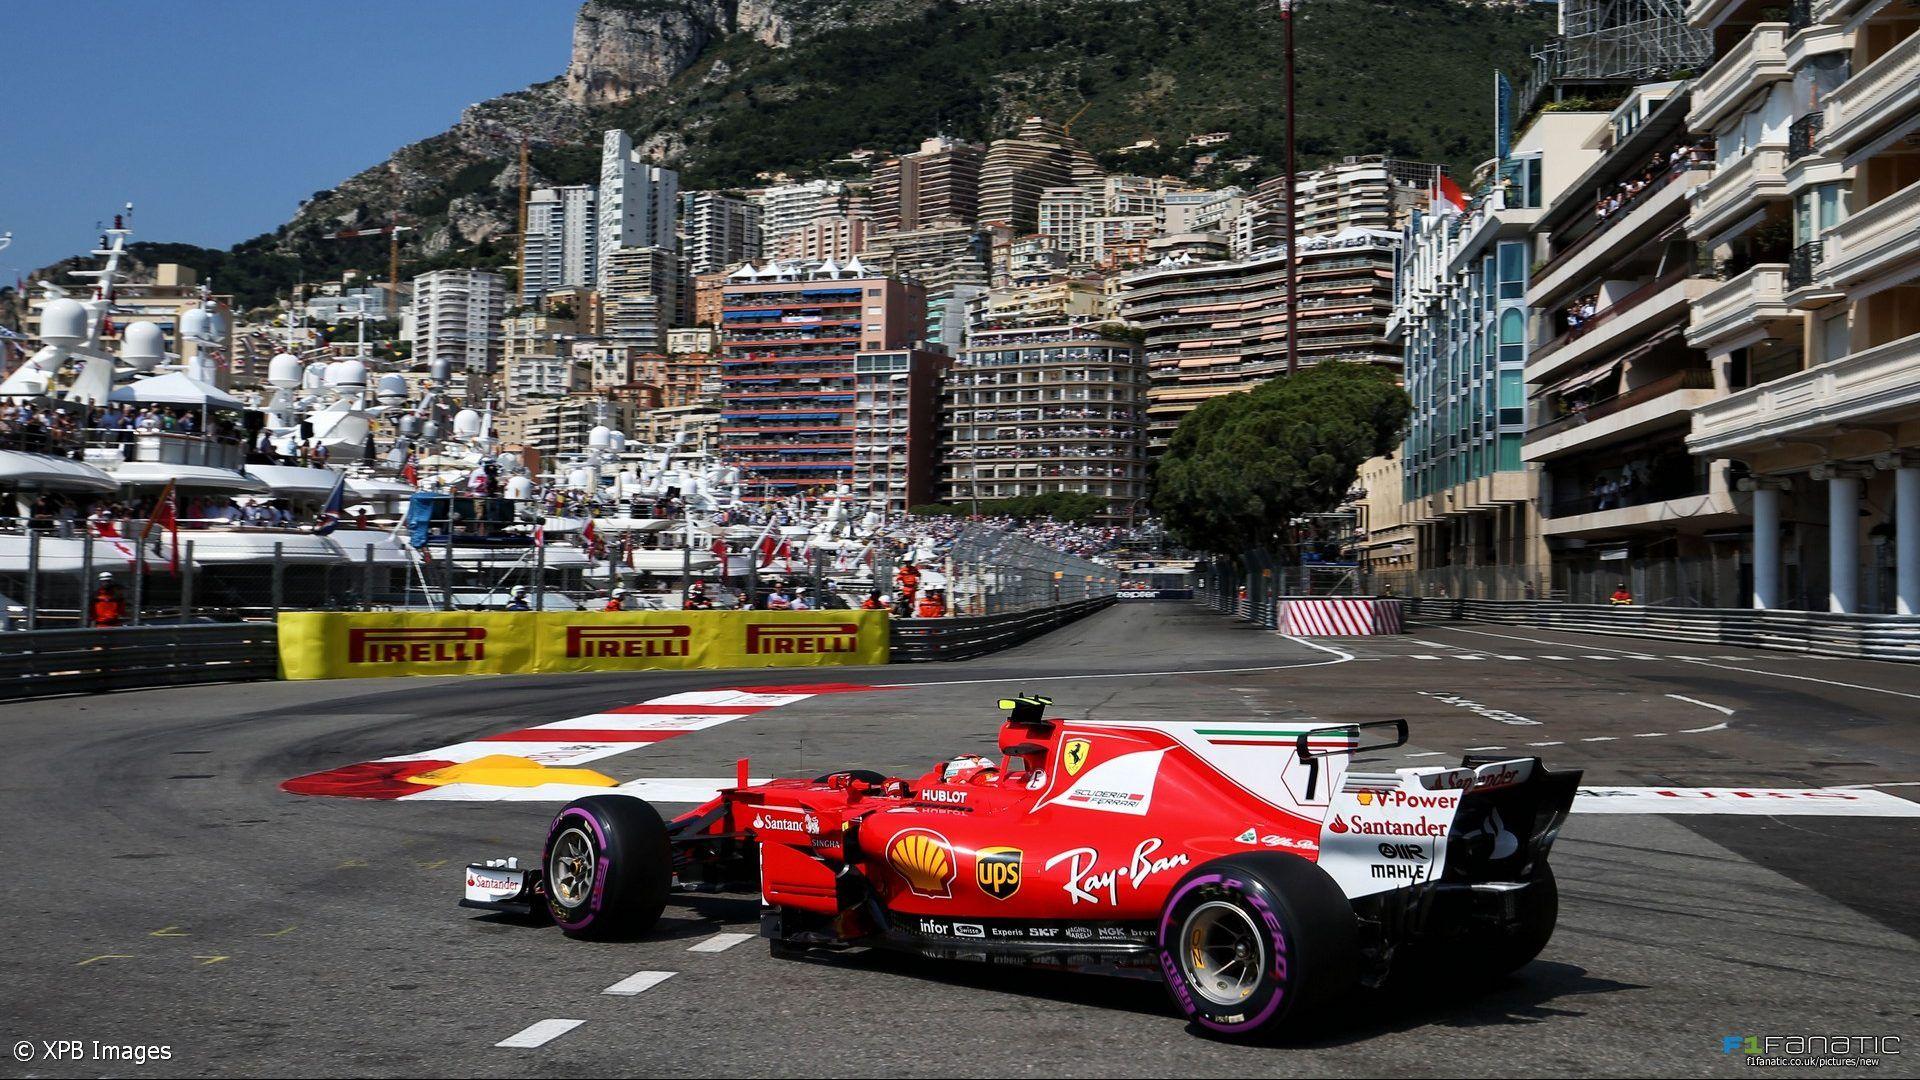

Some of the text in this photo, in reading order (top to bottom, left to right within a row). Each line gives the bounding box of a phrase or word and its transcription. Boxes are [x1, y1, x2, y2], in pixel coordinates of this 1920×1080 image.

[349, 627, 485, 664] PIRELLI
[566, 624, 691, 658] PIRELLI
[746, 623, 858, 654] PIRELLI
[921, 789, 968, 804] HUBLOT
[1074, 789, 1129, 799] SCUDERIA
[1375, 790, 1458, 809] V-Power
[1090, 797, 1140, 807] FERRARI
[1350, 815, 1448, 837] Santander
[811, 838, 841, 849] SINGHA
[979, 861, 1019, 893] ups
[1371, 864, 1424, 879] MAHLE
[475, 874, 519, 891] Santander
[919, 918, 949, 935] infor
[958, 925, 979, 935] Swisse
[991, 928, 1024, 938] Experis
[1029, 928, 1060, 937] SKF
[1098, 927, 1126, 936] NGK
